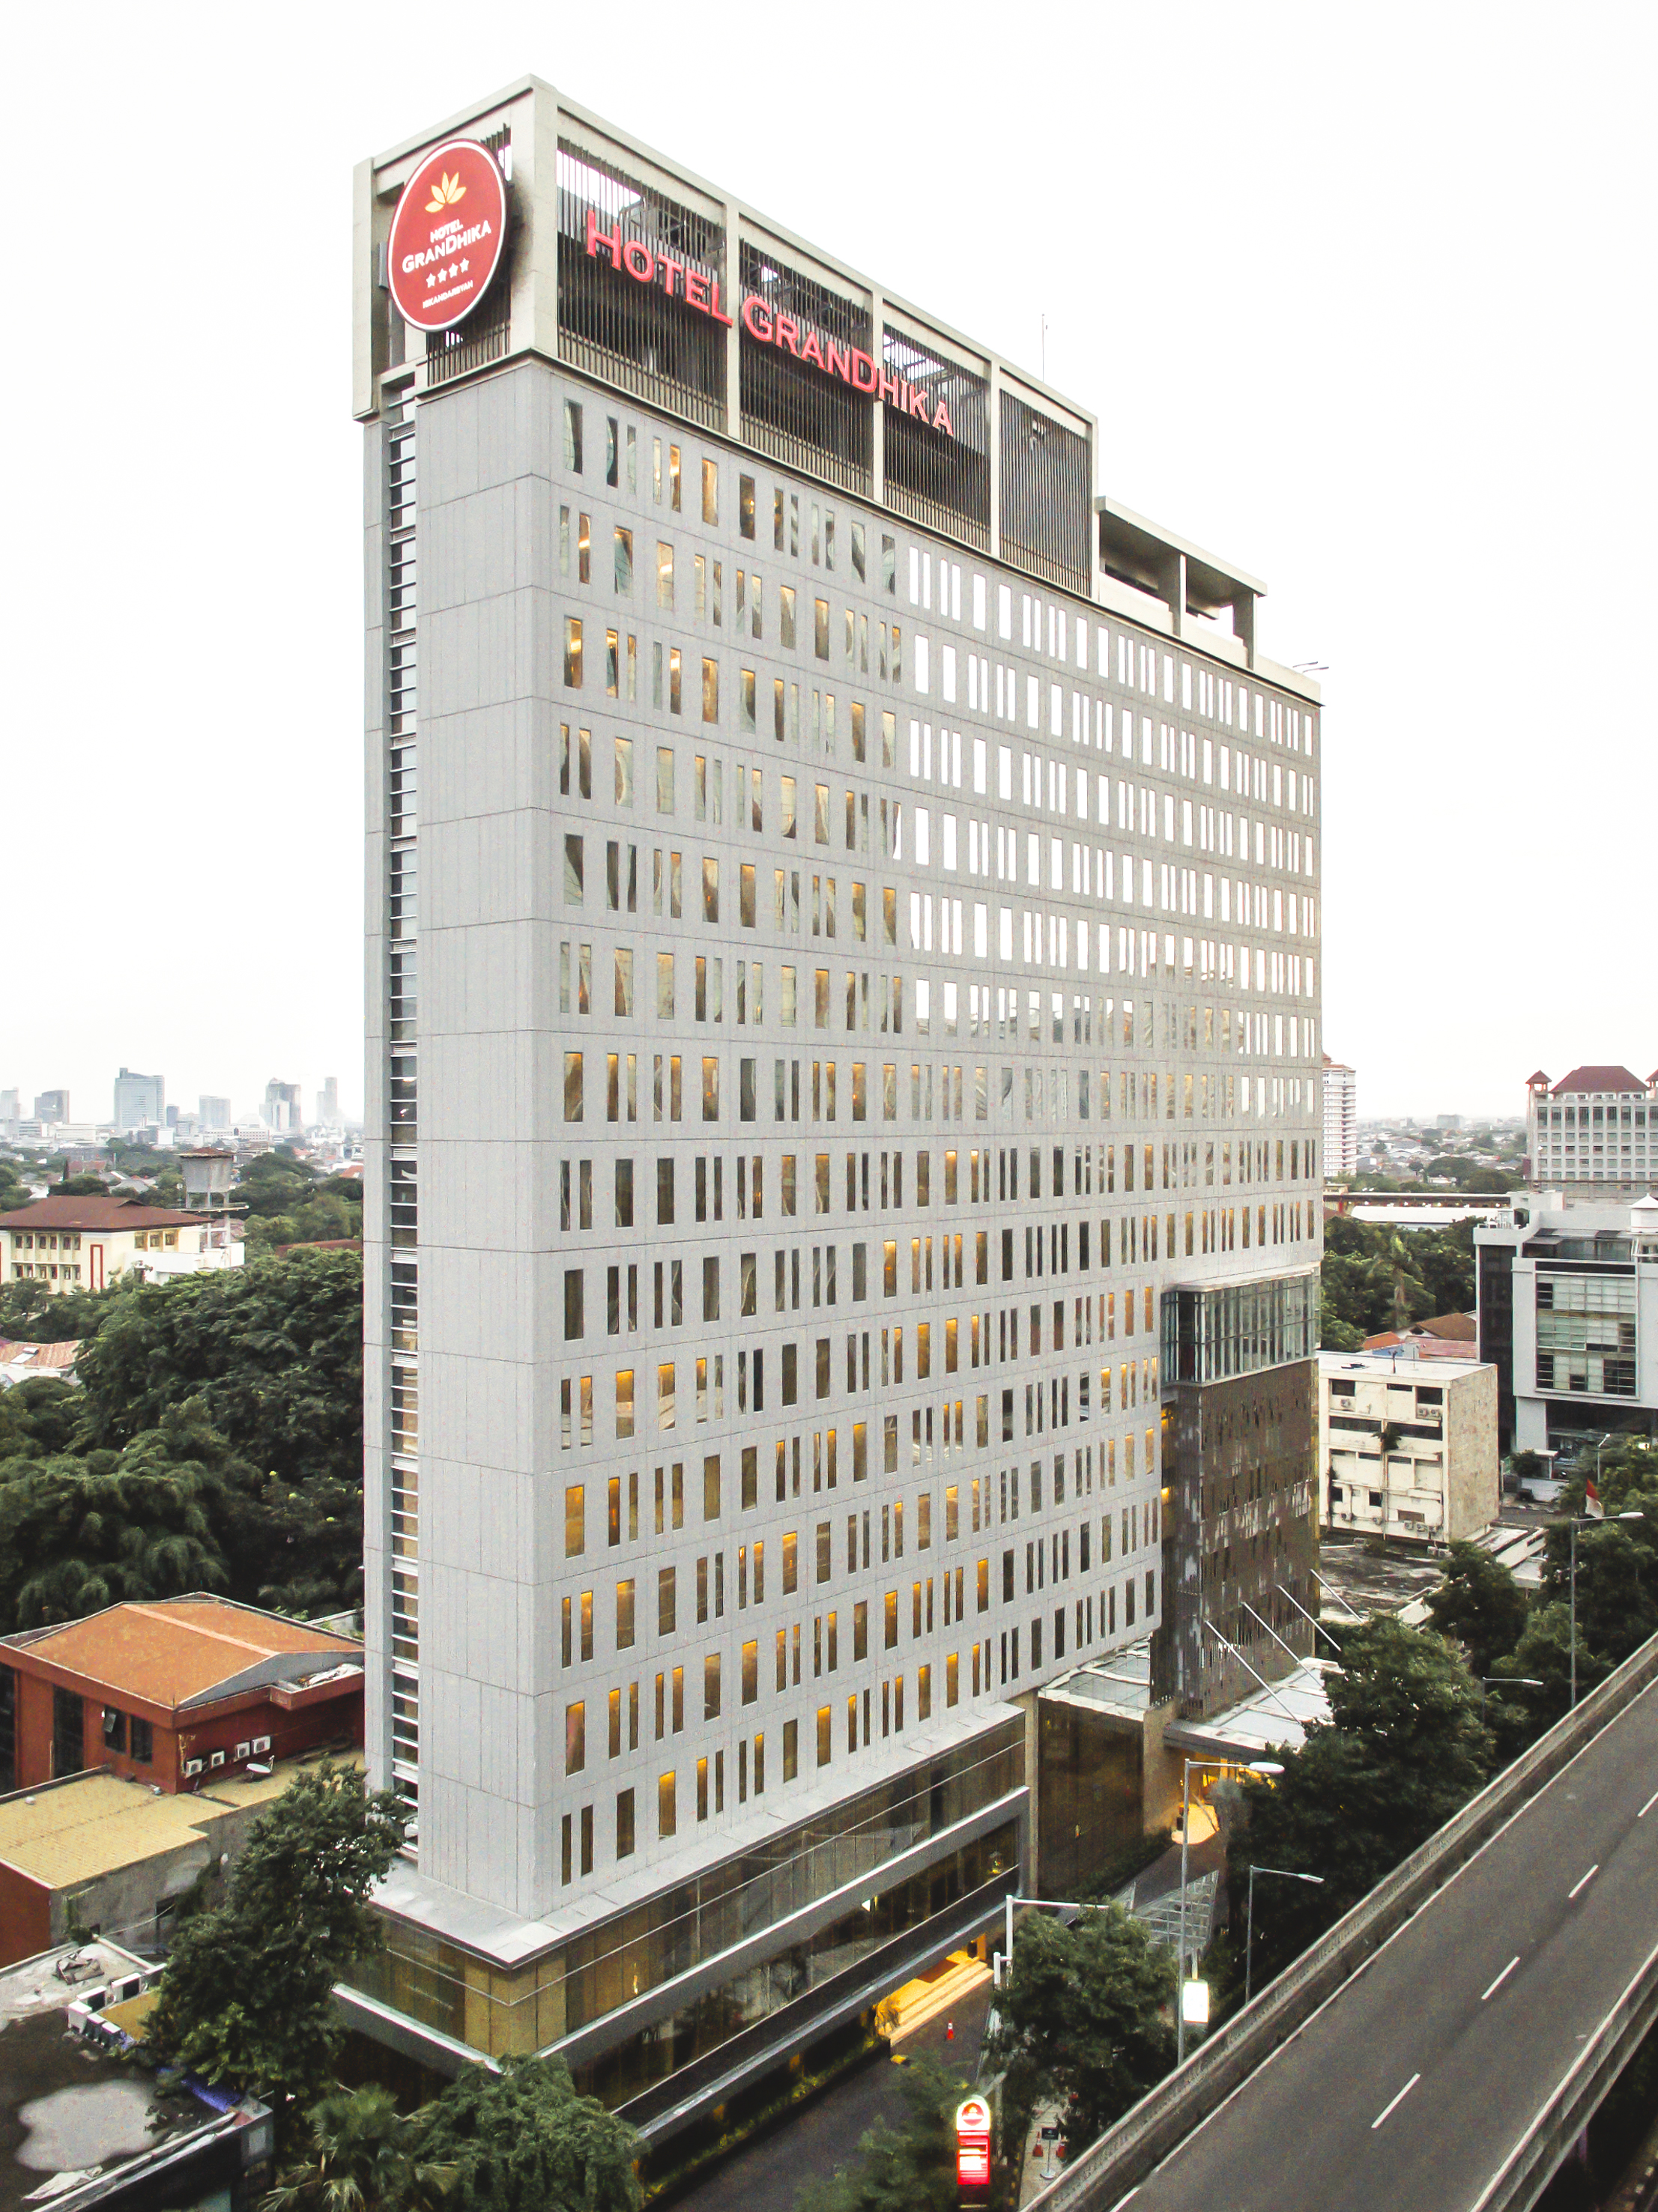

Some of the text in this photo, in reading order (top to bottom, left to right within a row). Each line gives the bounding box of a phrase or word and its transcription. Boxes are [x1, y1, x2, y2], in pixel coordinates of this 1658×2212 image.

[402, 219, 491, 273] GRANDHIKA
[430, 219, 464, 243] HOTEL
[586, 209, 954, 437] HOTEL GRANDHIKA
